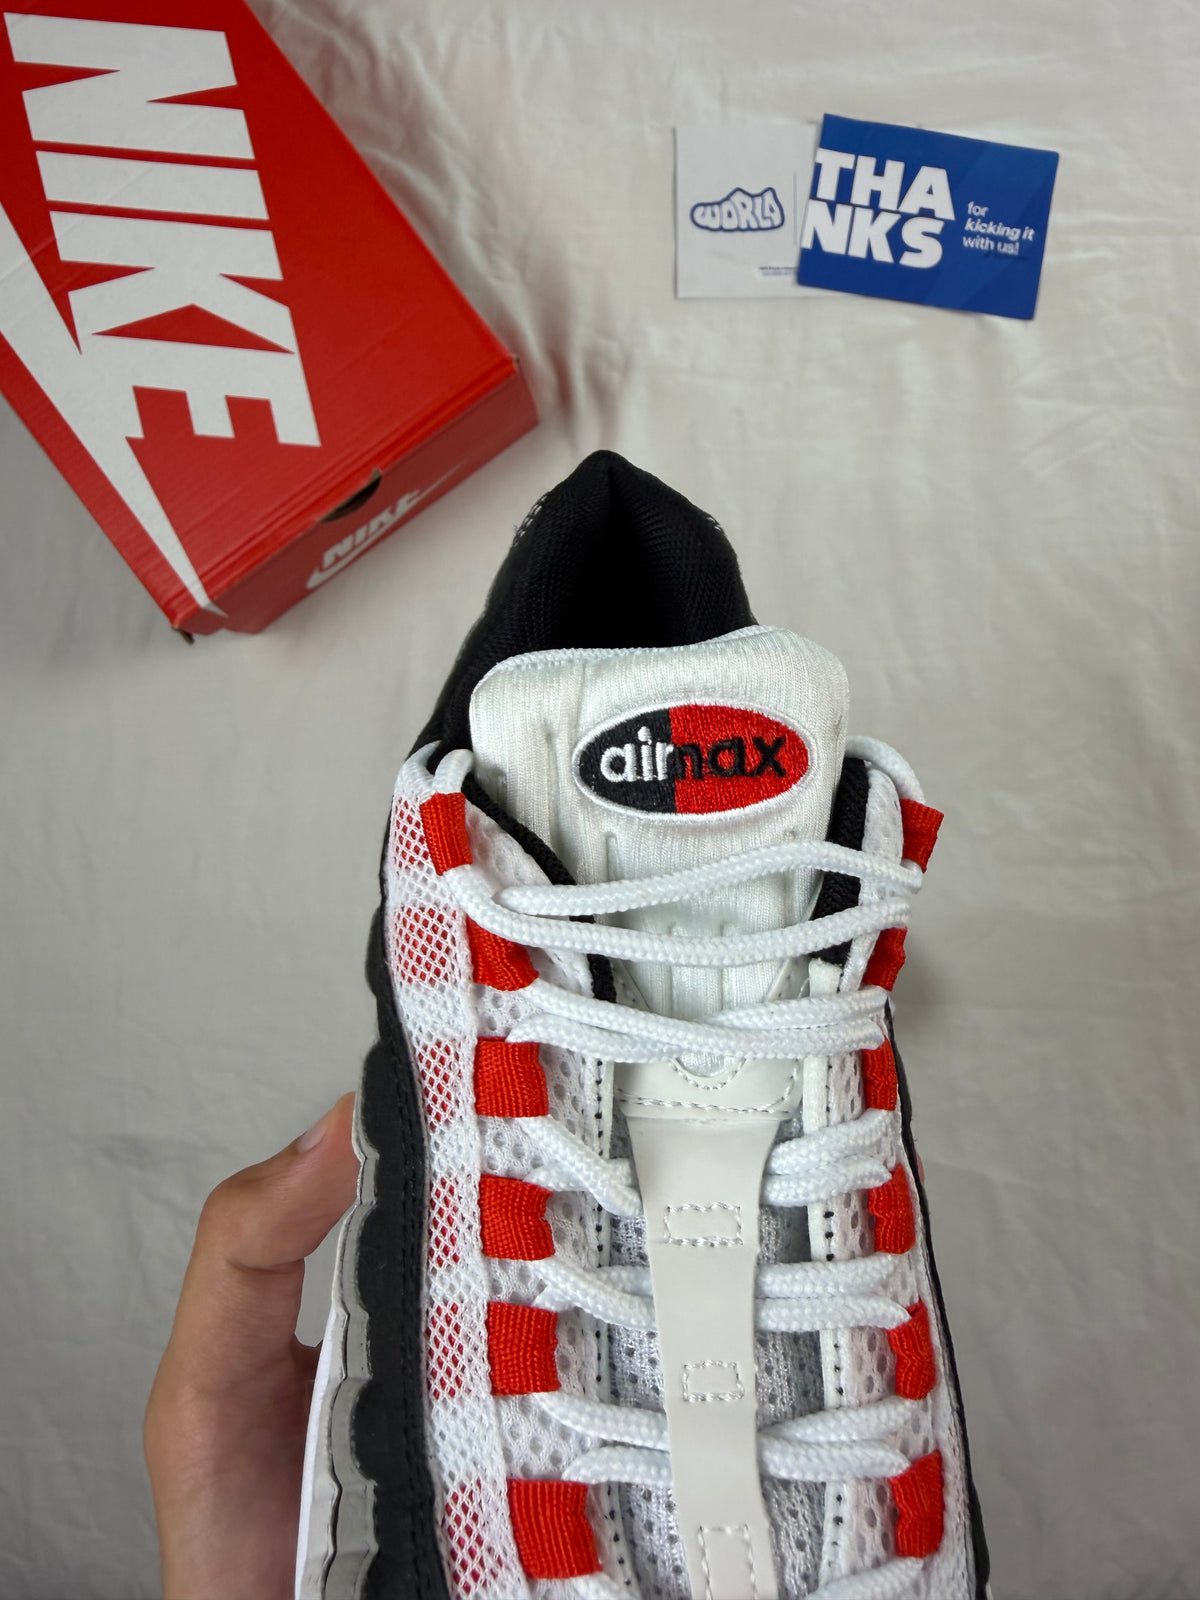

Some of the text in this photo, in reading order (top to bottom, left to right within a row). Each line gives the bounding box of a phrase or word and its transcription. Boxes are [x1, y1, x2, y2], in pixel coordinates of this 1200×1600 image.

[814, 147, 955, 221] THA
[967, 201, 989, 217] for
[3, 12, 322, 447] NIKE
[801, 199, 945, 270] NKS
[962, 235, 1020, 256] with us!
[964, 217, 1035, 241] kicking it
[322, 489, 421, 569] NIKE
